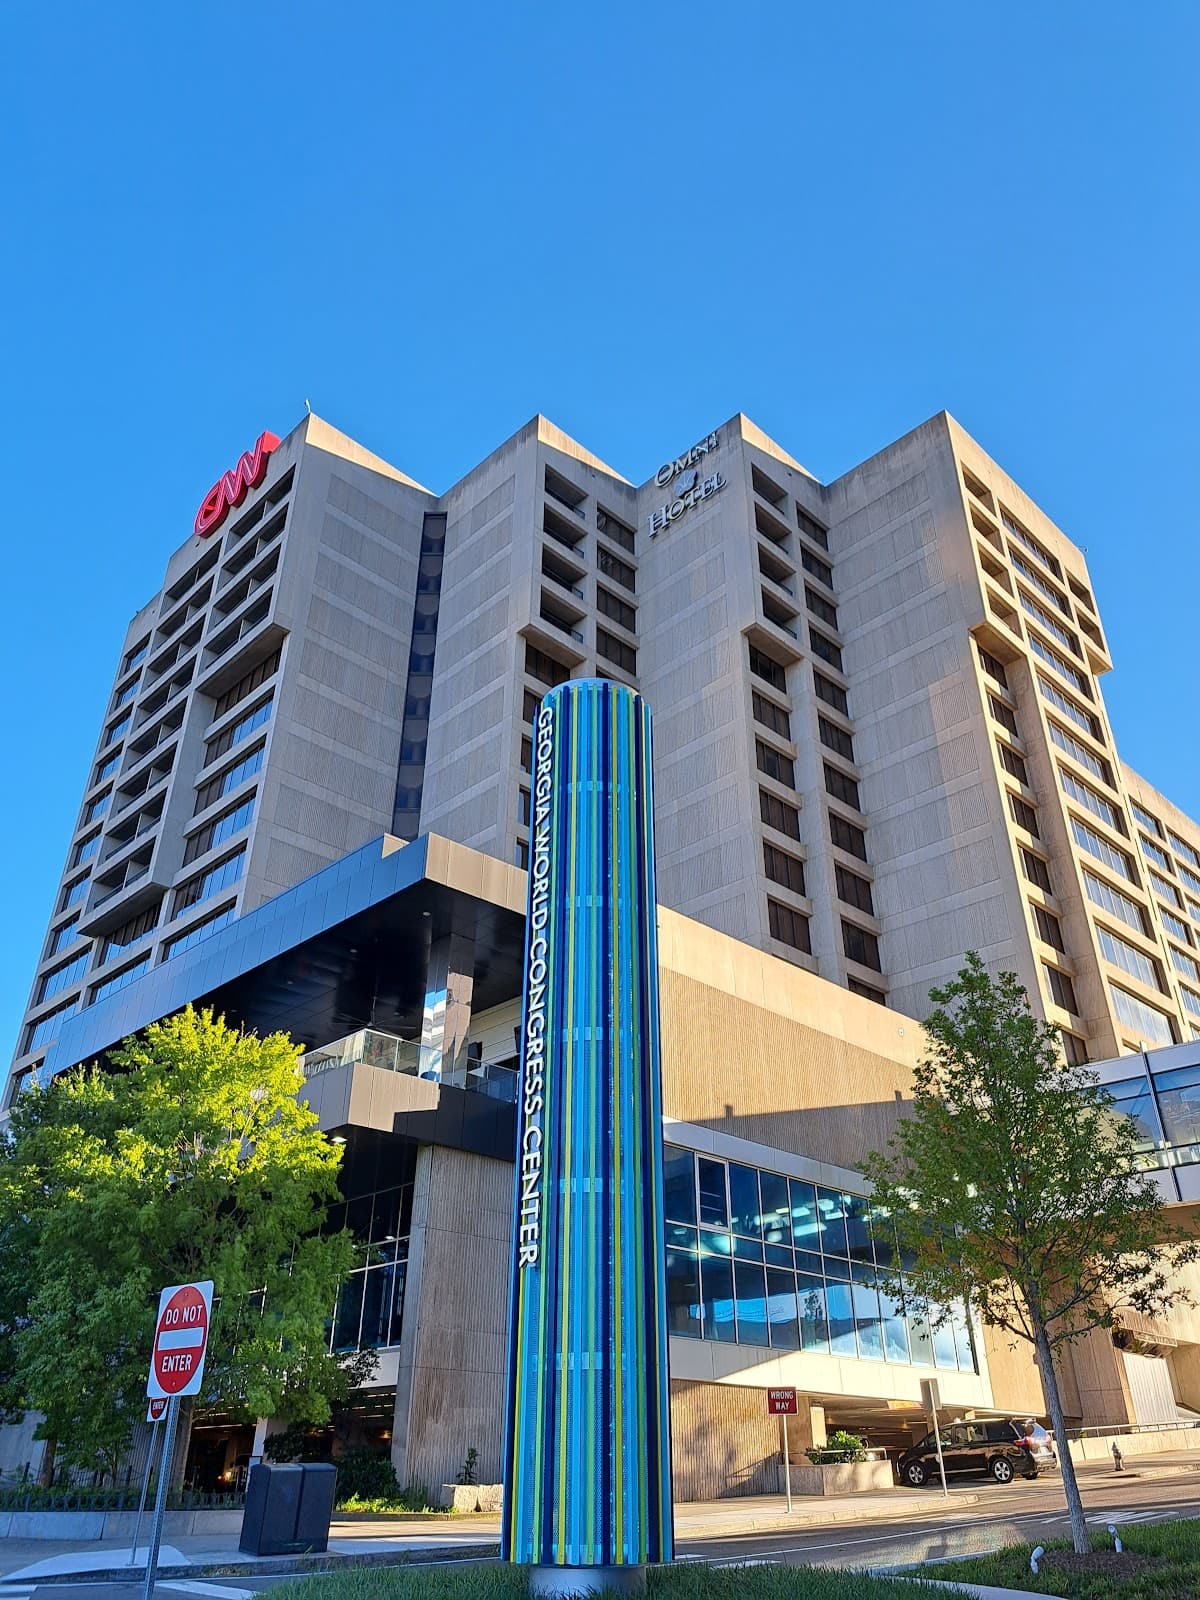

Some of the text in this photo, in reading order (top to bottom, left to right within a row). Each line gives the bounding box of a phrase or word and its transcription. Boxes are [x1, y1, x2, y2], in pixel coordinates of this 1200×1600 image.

[655, 432, 720, 488] OMNI
[193, 430, 280, 538] CNN
[648, 472, 727, 538] HOTEL
[519, 706, 553, 1268] GEORGIA WORLD CONGRESS CENTER
[165, 1305, 203, 1325] DO NOT
[161, 1354, 193, 1373] ENTER
[770, 1391, 794, 1400] WRONG
[775, 1401, 790, 1411] WAY
